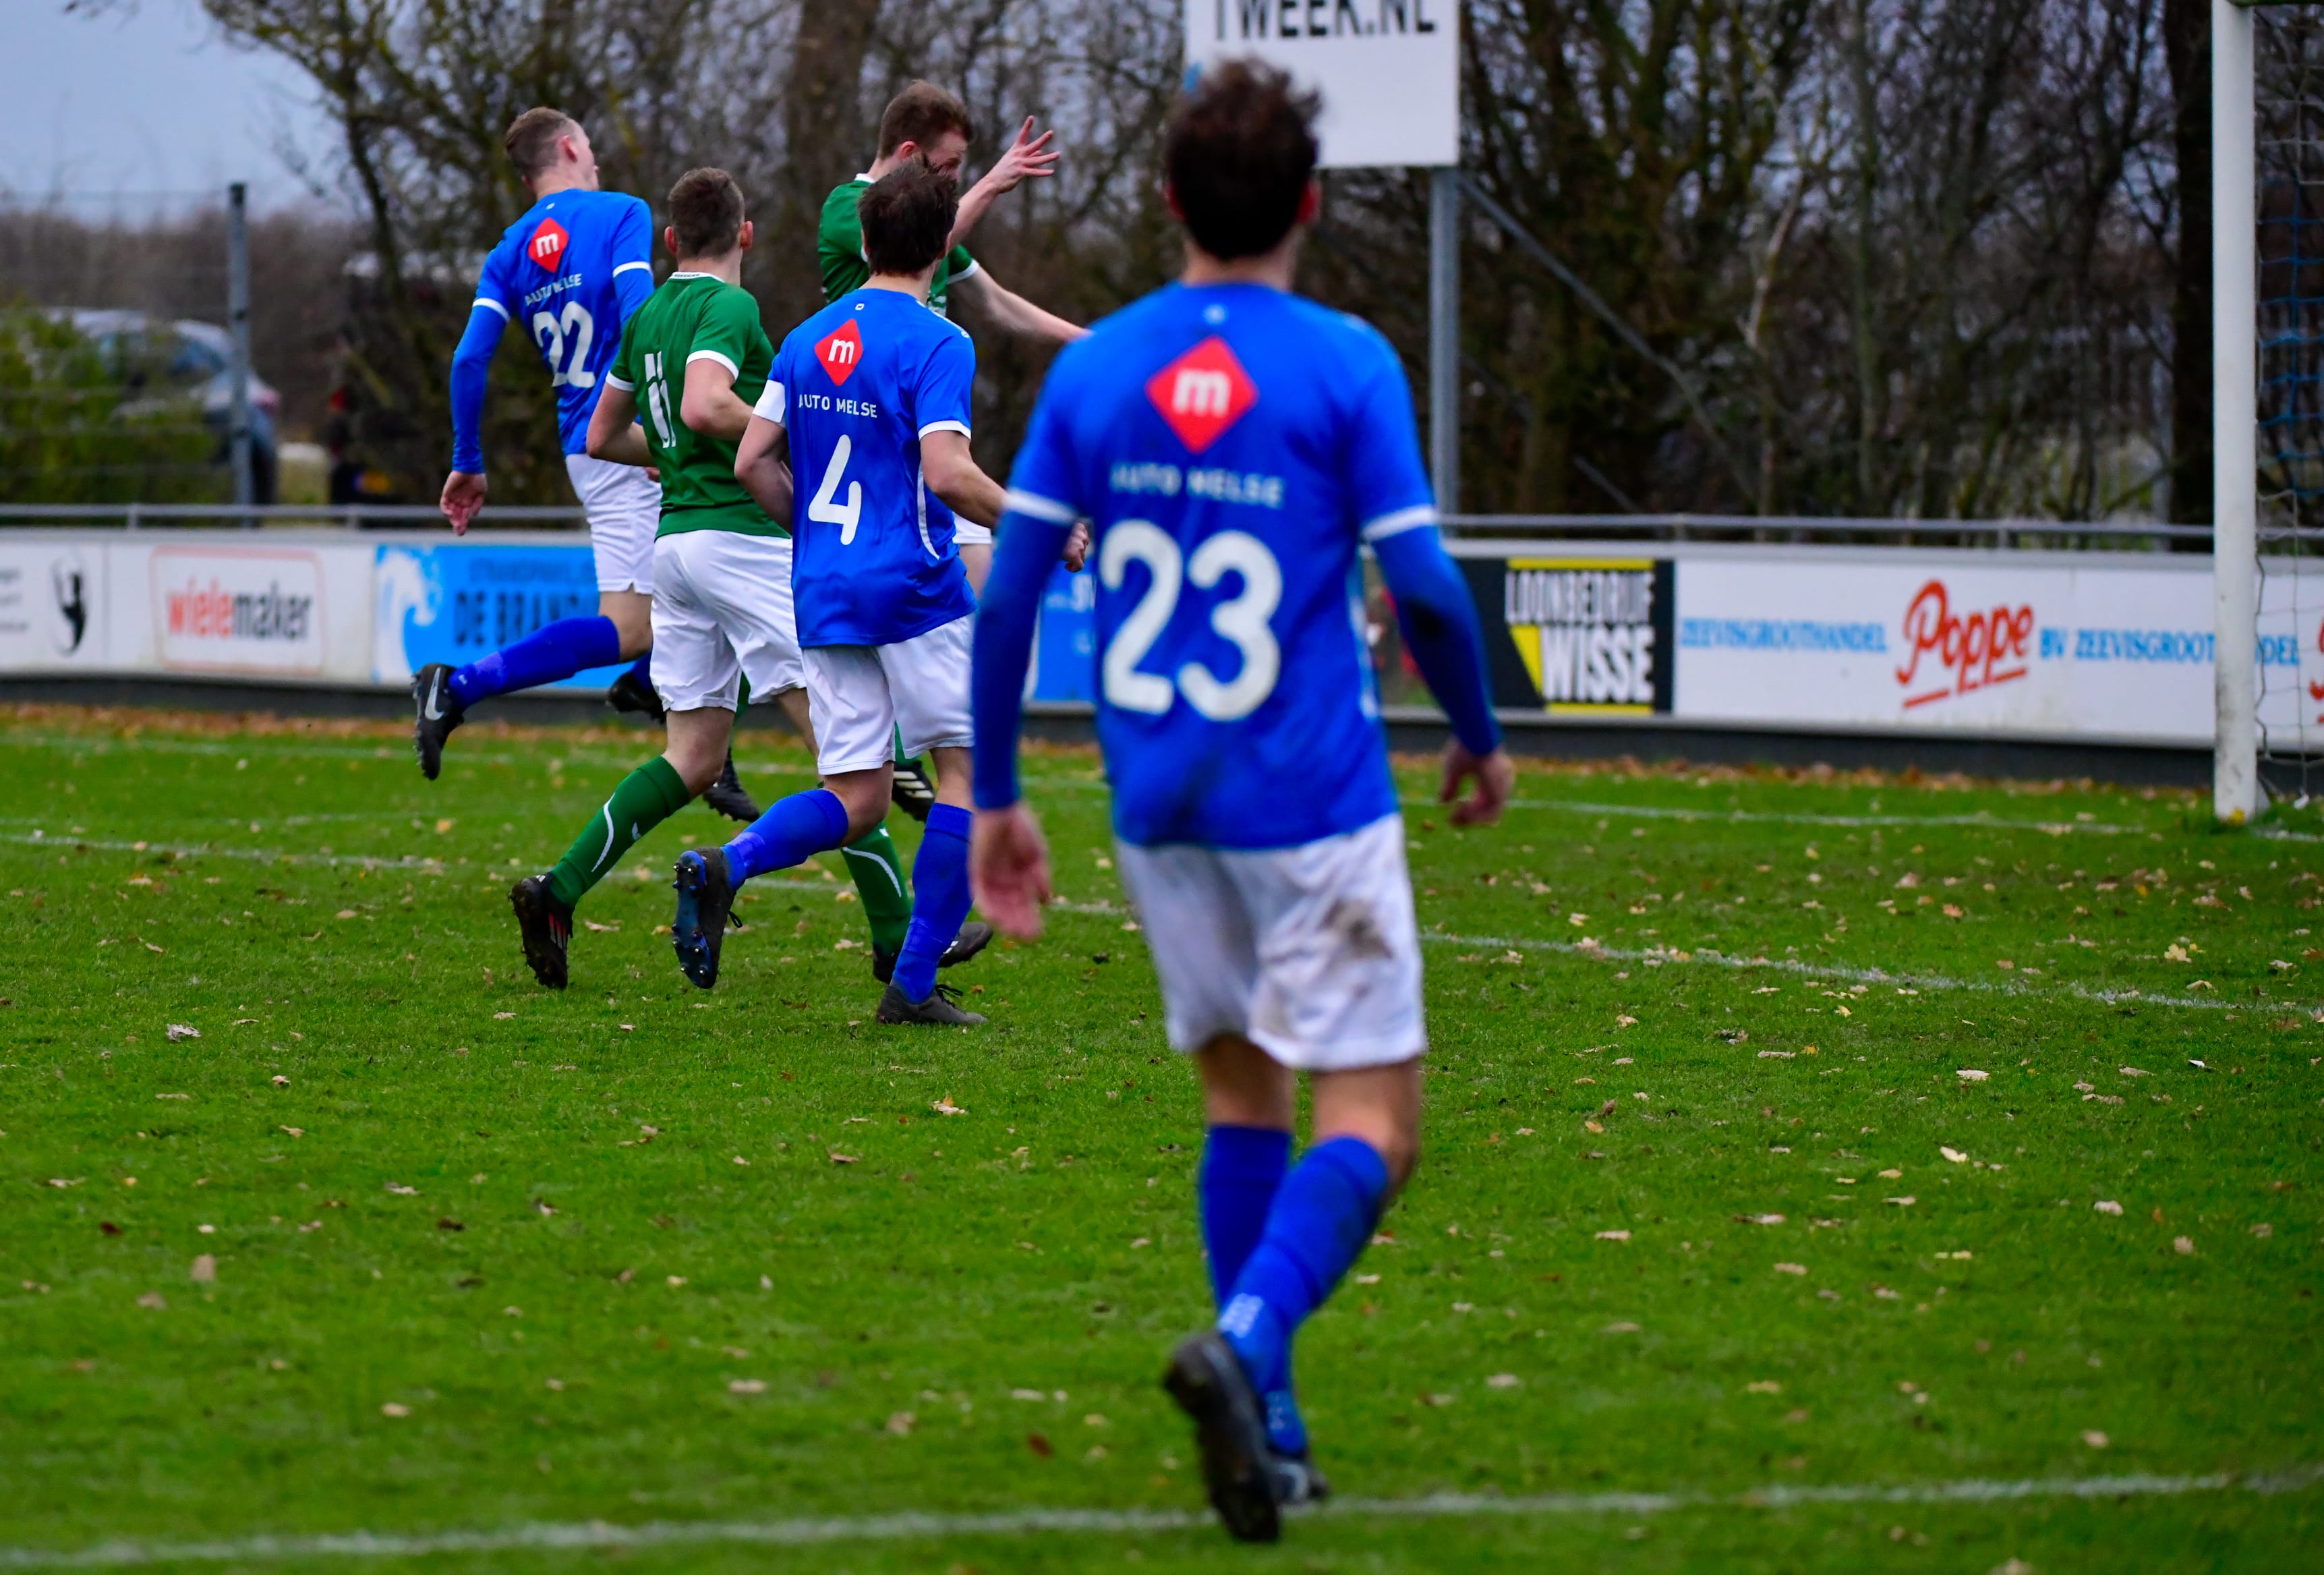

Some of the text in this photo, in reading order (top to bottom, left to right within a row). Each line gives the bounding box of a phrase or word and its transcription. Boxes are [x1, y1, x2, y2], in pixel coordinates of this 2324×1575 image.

[535, 233, 560, 258] m
[533, 301, 596, 389] 22
[827, 338, 855, 364] m
[644, 351, 676, 449] 11
[798, 394, 877, 418] AUTO MELSE
[1172, 368, 1233, 418] m
[808, 434, 863, 546] 4
[1110, 461, 1283, 510] AUTO MELSE
[167, 577, 314, 641] wielemaker
[1098, 518, 1283, 722] 23
[1896, 579, 2034, 694] Poppe
[2040, 627, 2067, 660] BV
[2074, 627, 2301, 665] ZEEVISGROOTDEL
[1540, 625, 1655, 702] WISSE
